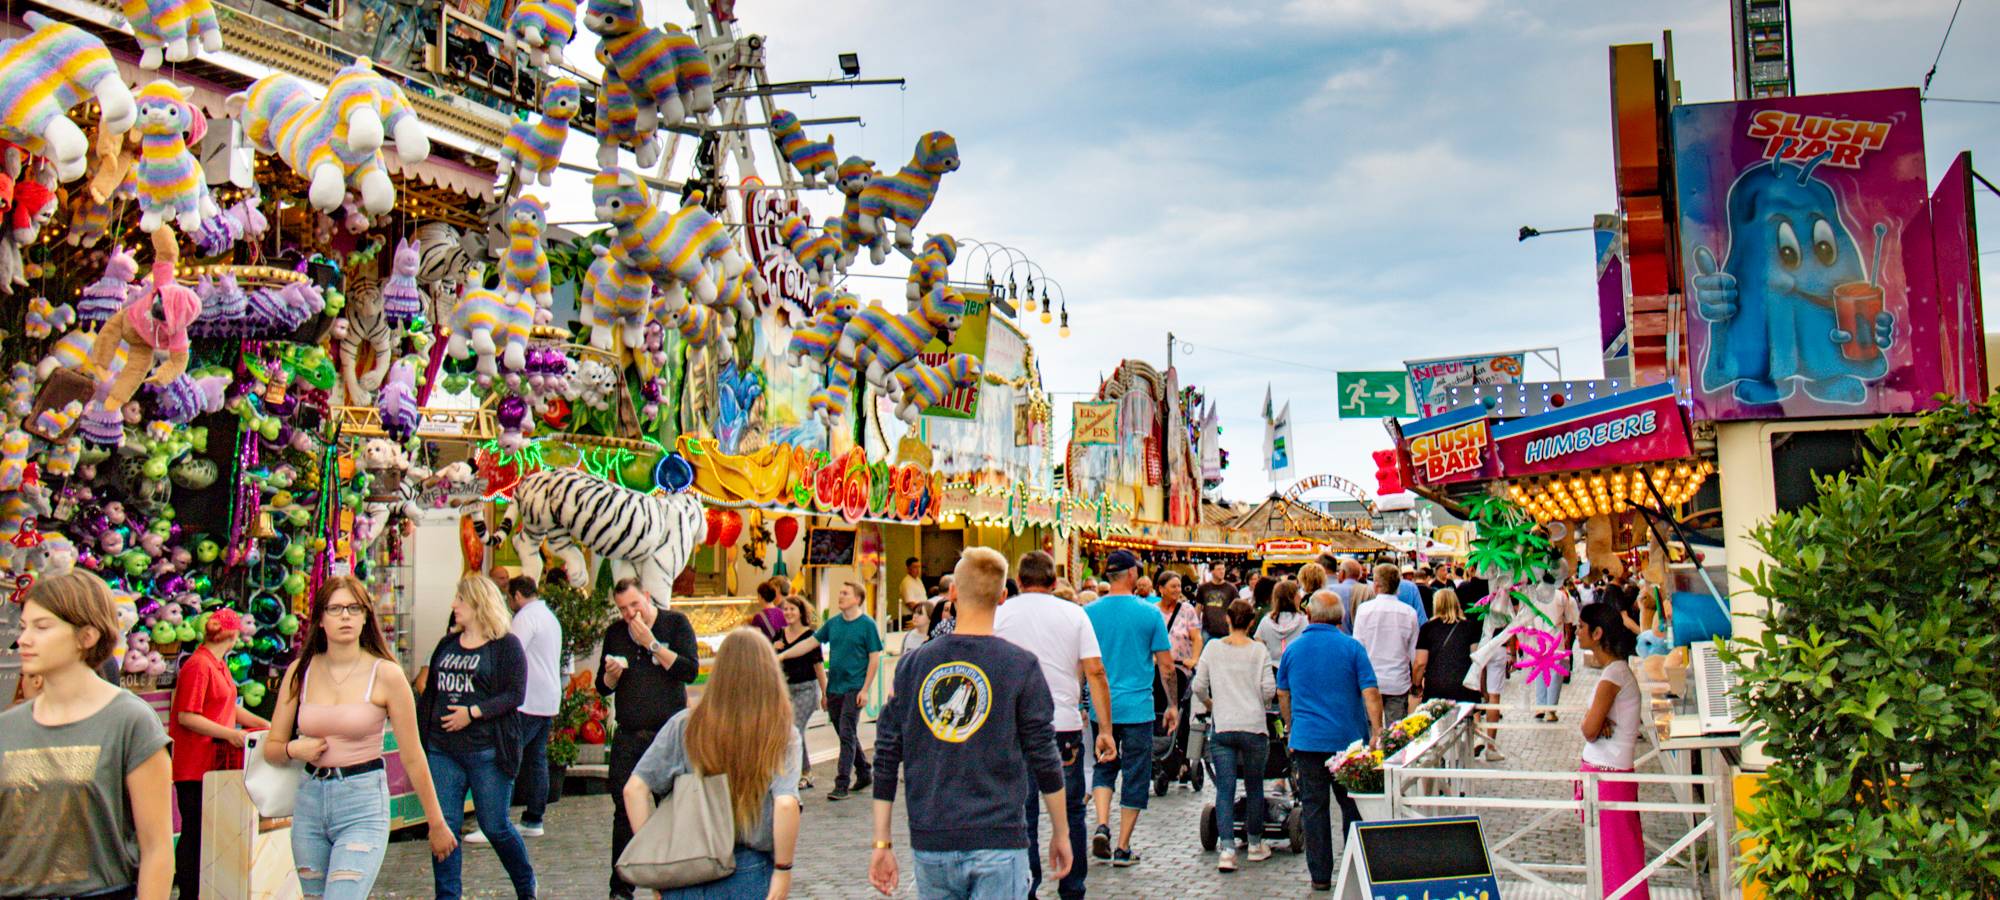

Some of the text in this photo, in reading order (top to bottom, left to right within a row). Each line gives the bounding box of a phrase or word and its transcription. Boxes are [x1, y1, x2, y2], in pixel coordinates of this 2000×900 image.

[1747, 110, 1892, 150] SLUSH
[1762, 136, 1861, 168] BAR
[1080, 408, 1096, 418] EIS
[1093, 427, 1110, 437] EIS
[1410, 419, 1488, 466] SLUSH
[1524, 409, 1658, 465] HIMBEERE
[1426, 447, 1483, 482] BAR
[439, 654, 480, 669] HARD
[437, 671, 475, 692] ROCK
